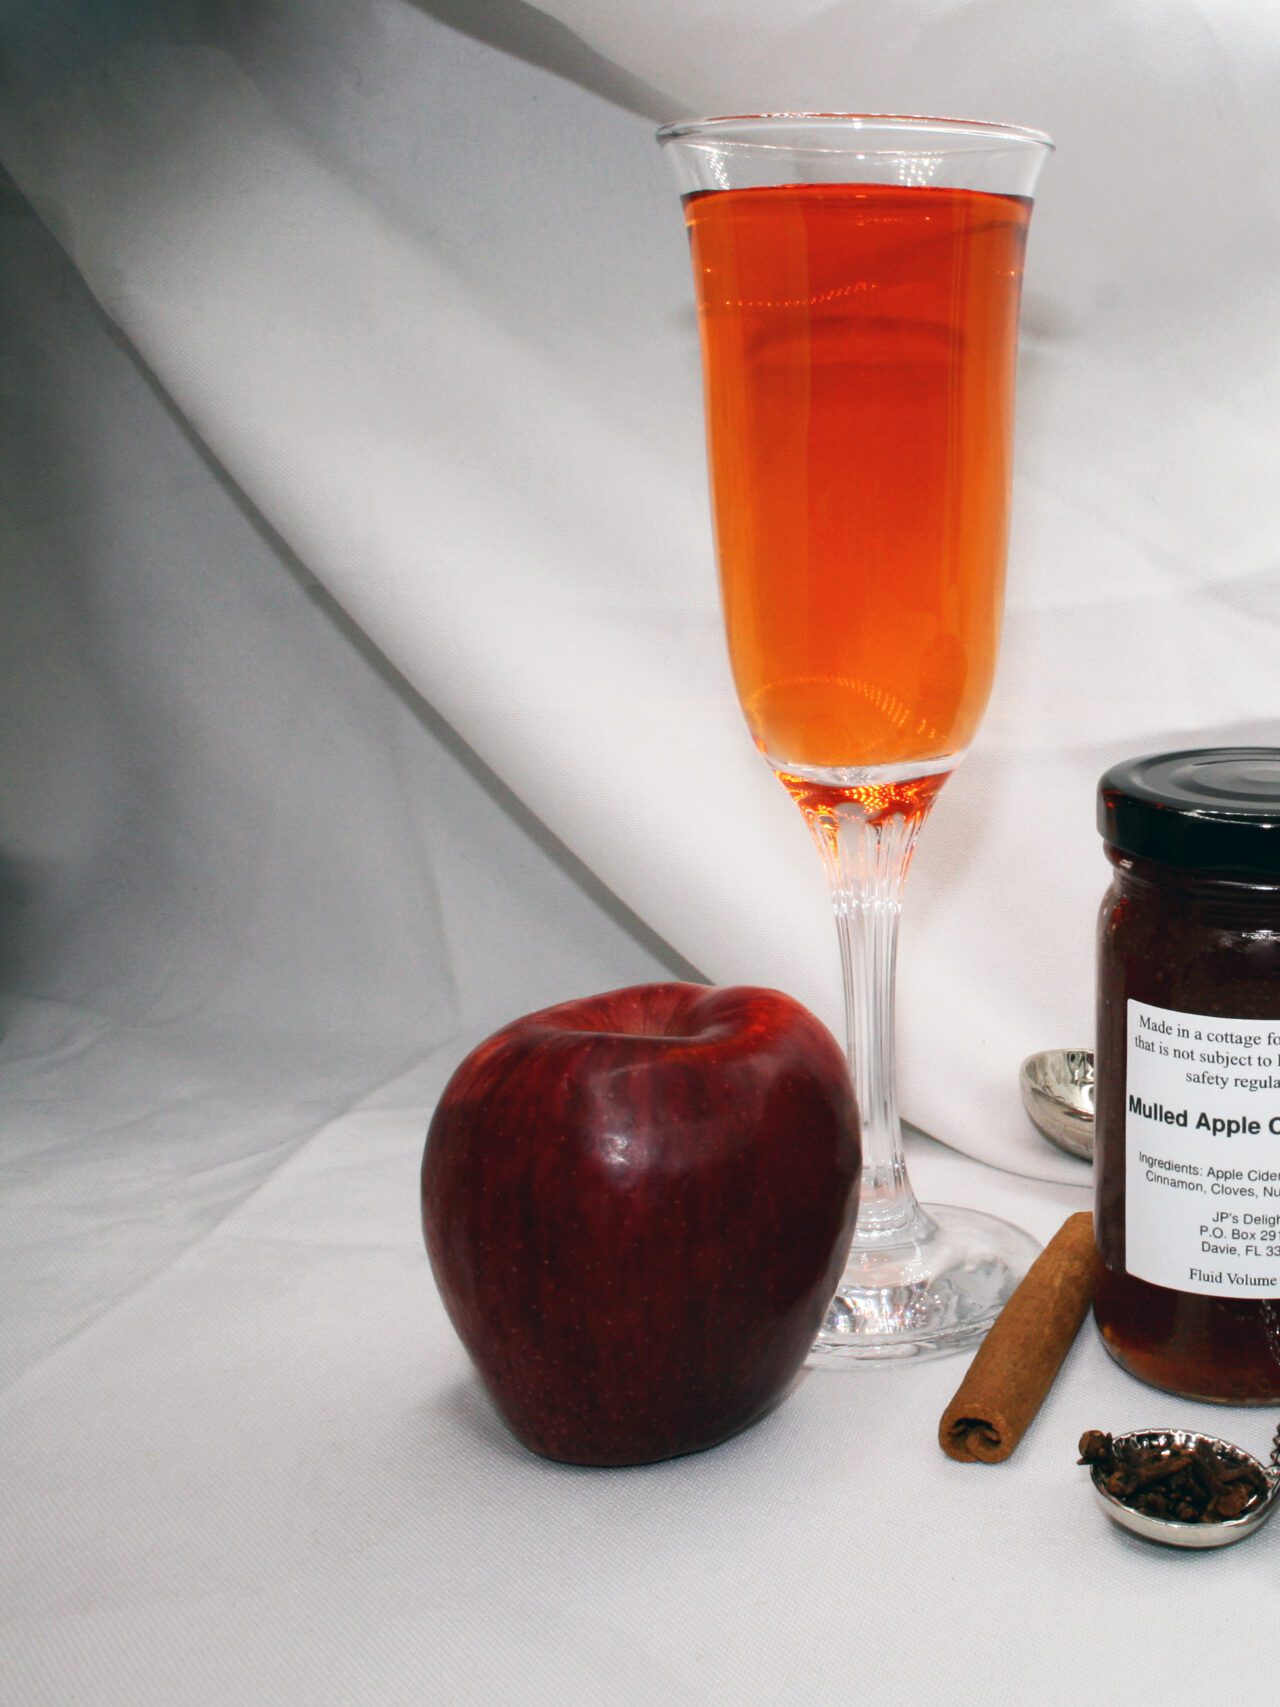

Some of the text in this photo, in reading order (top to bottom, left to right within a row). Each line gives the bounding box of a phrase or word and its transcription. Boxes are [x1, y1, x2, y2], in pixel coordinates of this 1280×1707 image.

[1138, 1014, 1173, 1036] Made
[1176, 1023, 1190, 1039] in
[1194, 1030, 1202, 1041] a
[1206, 1032, 1262, 1049] cottage
[1134, 1034, 1156, 1053] that
[1158, 1043, 1170, 1056] is
[1173, 1048, 1196, 1062] not
[1199, 1050, 1253, 1069] subject
[1257, 1055, 1273, 1068] to
[1185, 1070, 1229, 1090] safety
[1128, 1094, 1188, 1128] Mulled
[1195, 1111, 1262, 1139] Apple
[1138, 1151, 1203, 1177] Ingredients:
[1206, 1166, 1244, 1183] Apple
[1145, 1169, 1207, 1195] Cinnamon,
[1210, 1182, 1259, 1199] Cloves,
[1211, 1211, 1239, 1224] JP's
[1199, 1224, 1228, 1240] P.O.
[1231, 1228, 1257, 1241] Box
[1201, 1240, 1241, 1258] Davie,
[1245, 1244, 1262, 1257] FL
[1189, 1267, 1223, 1284] Fluid
[1226, 1272, 1278, 1287] Volume
